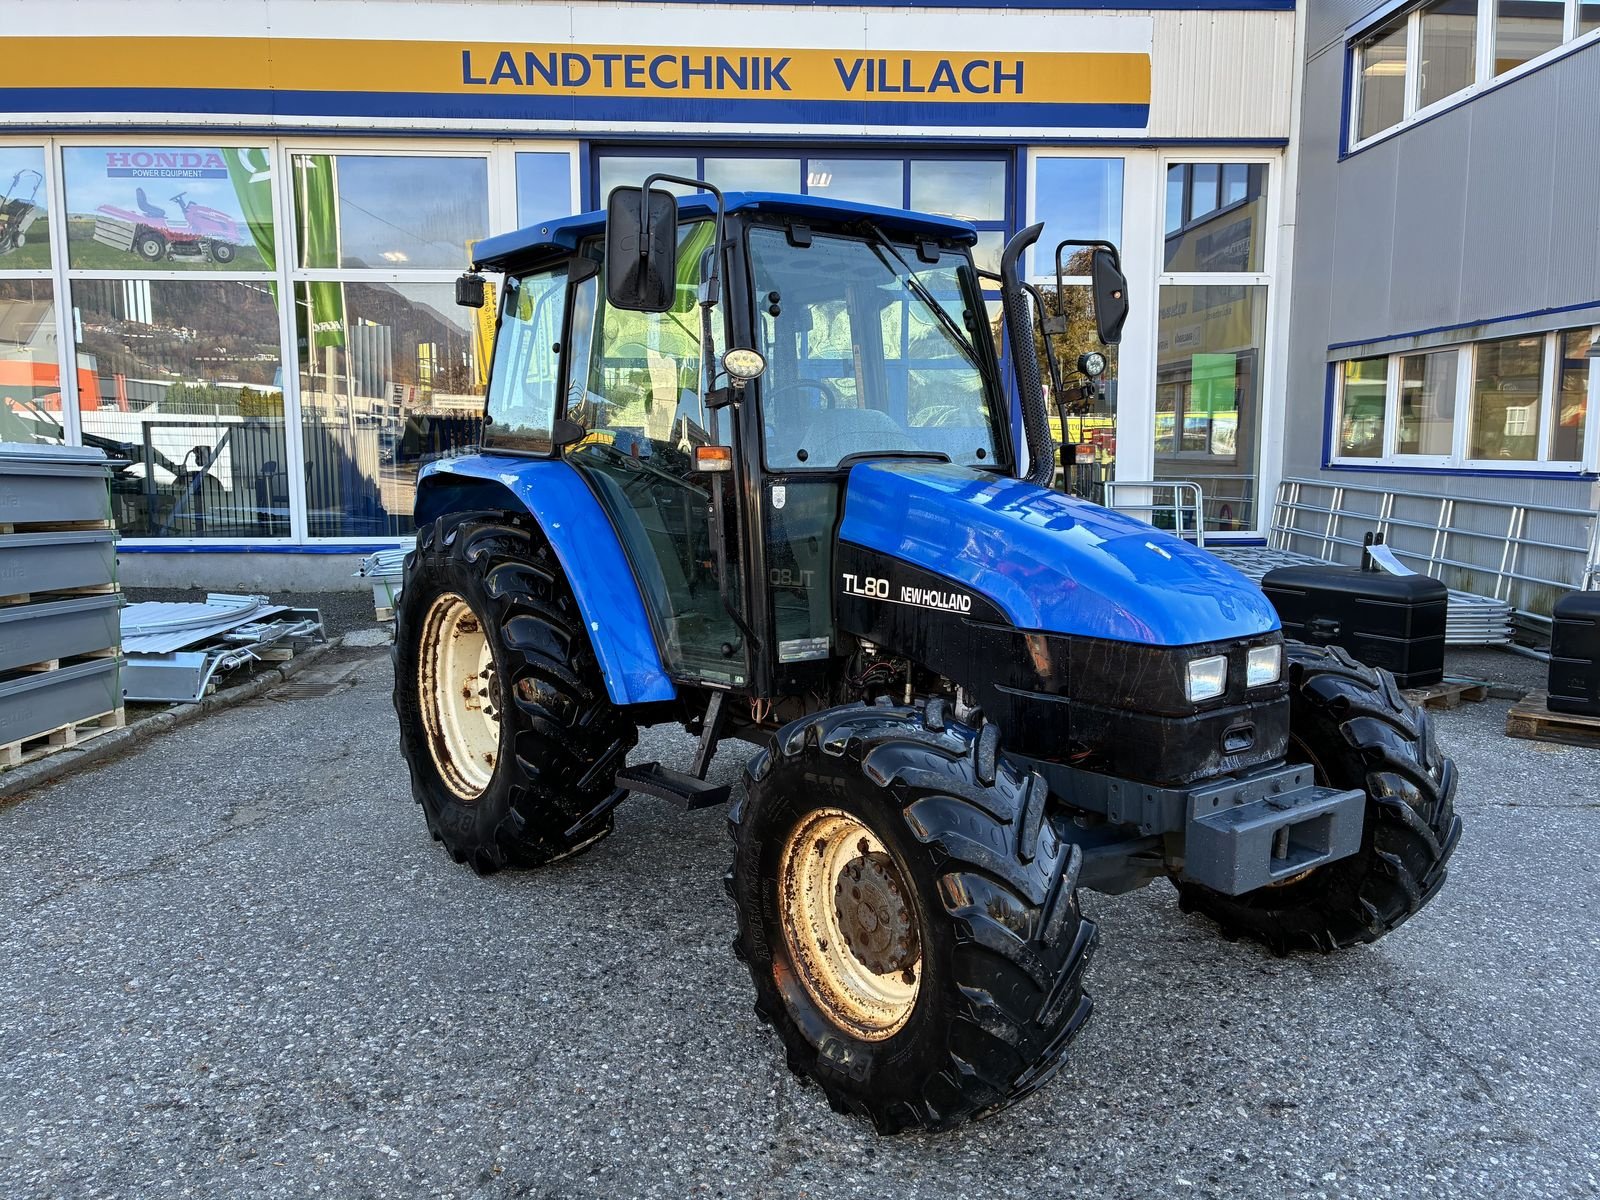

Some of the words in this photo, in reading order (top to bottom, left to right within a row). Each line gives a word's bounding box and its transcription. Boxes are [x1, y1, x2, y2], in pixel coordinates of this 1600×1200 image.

[462, 50, 792, 91] LANDTECHNIK
[833, 57, 1024, 94] VILLACH
[106, 152, 227, 168] HONDA
[132, 169, 159, 177] POWER
[160, 169, 203, 178] EQUIPMENT
[842, 573, 890, 598] TL80
[901, 586, 922, 603] NEW
[922, 590, 972, 612] HOLLAND
